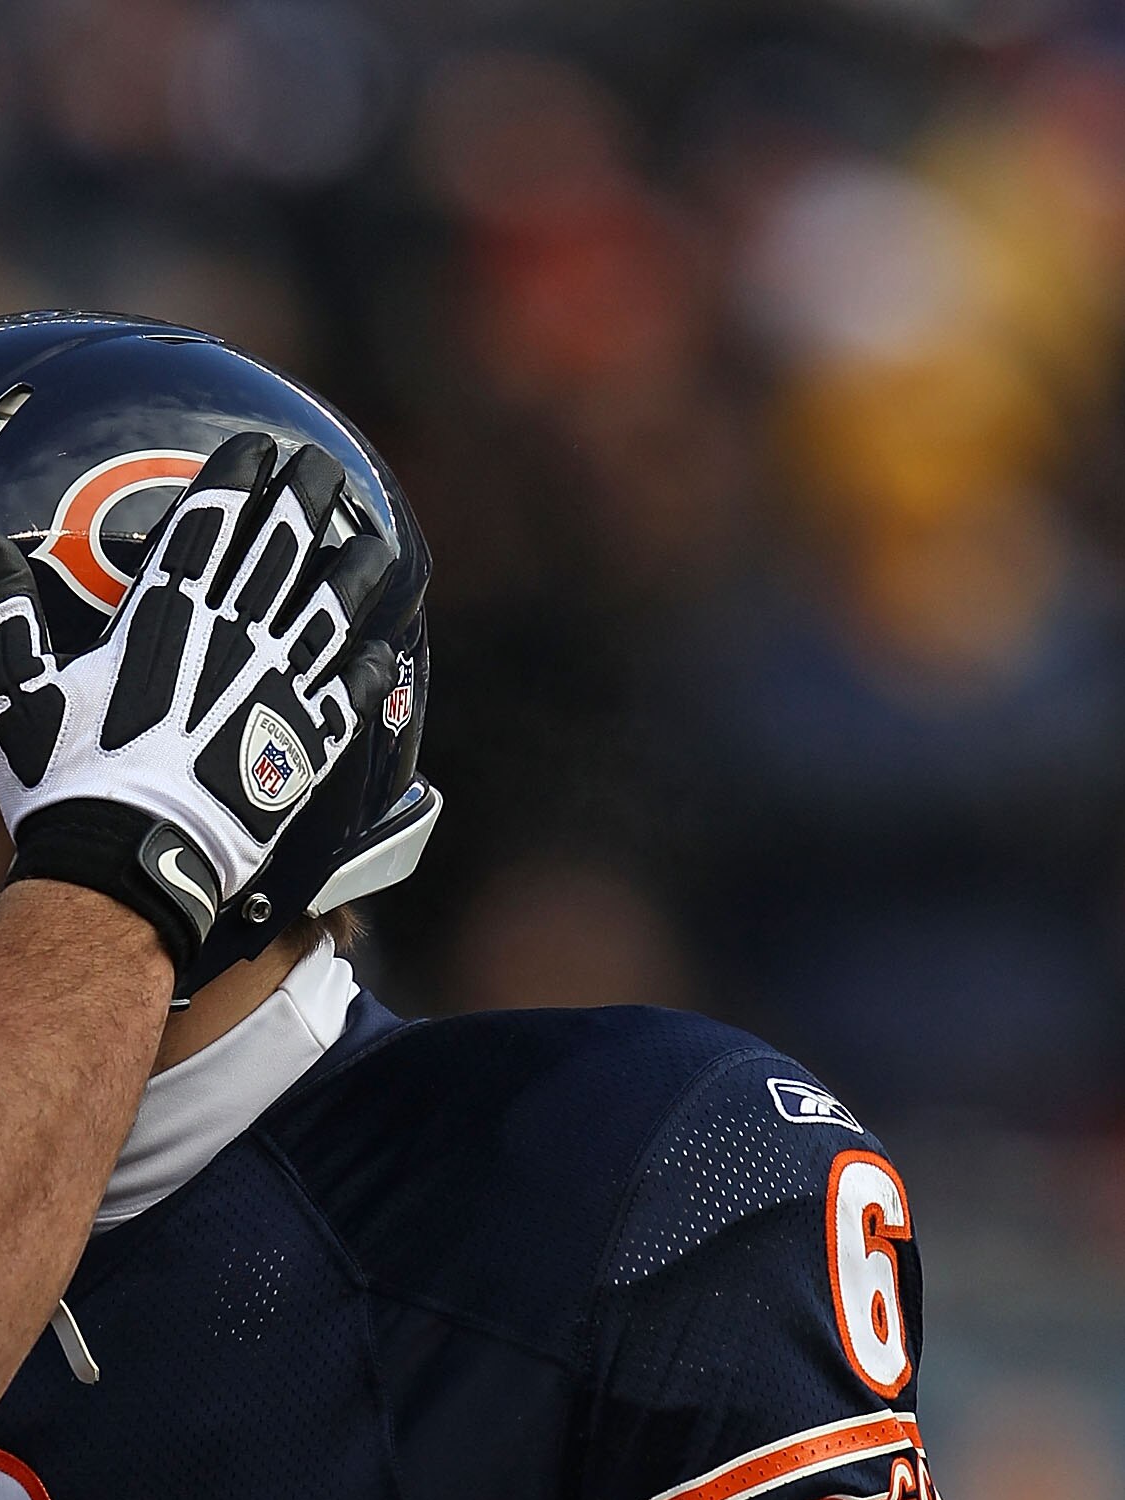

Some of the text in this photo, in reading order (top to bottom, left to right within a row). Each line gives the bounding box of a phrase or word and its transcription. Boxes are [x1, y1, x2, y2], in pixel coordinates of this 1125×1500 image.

[388, 688, 409, 722] NFL
[259, 718, 307, 780] EQUIPMENT
[255, 756, 282, 795] NFL
[826, 1149, 912, 1399] 6
